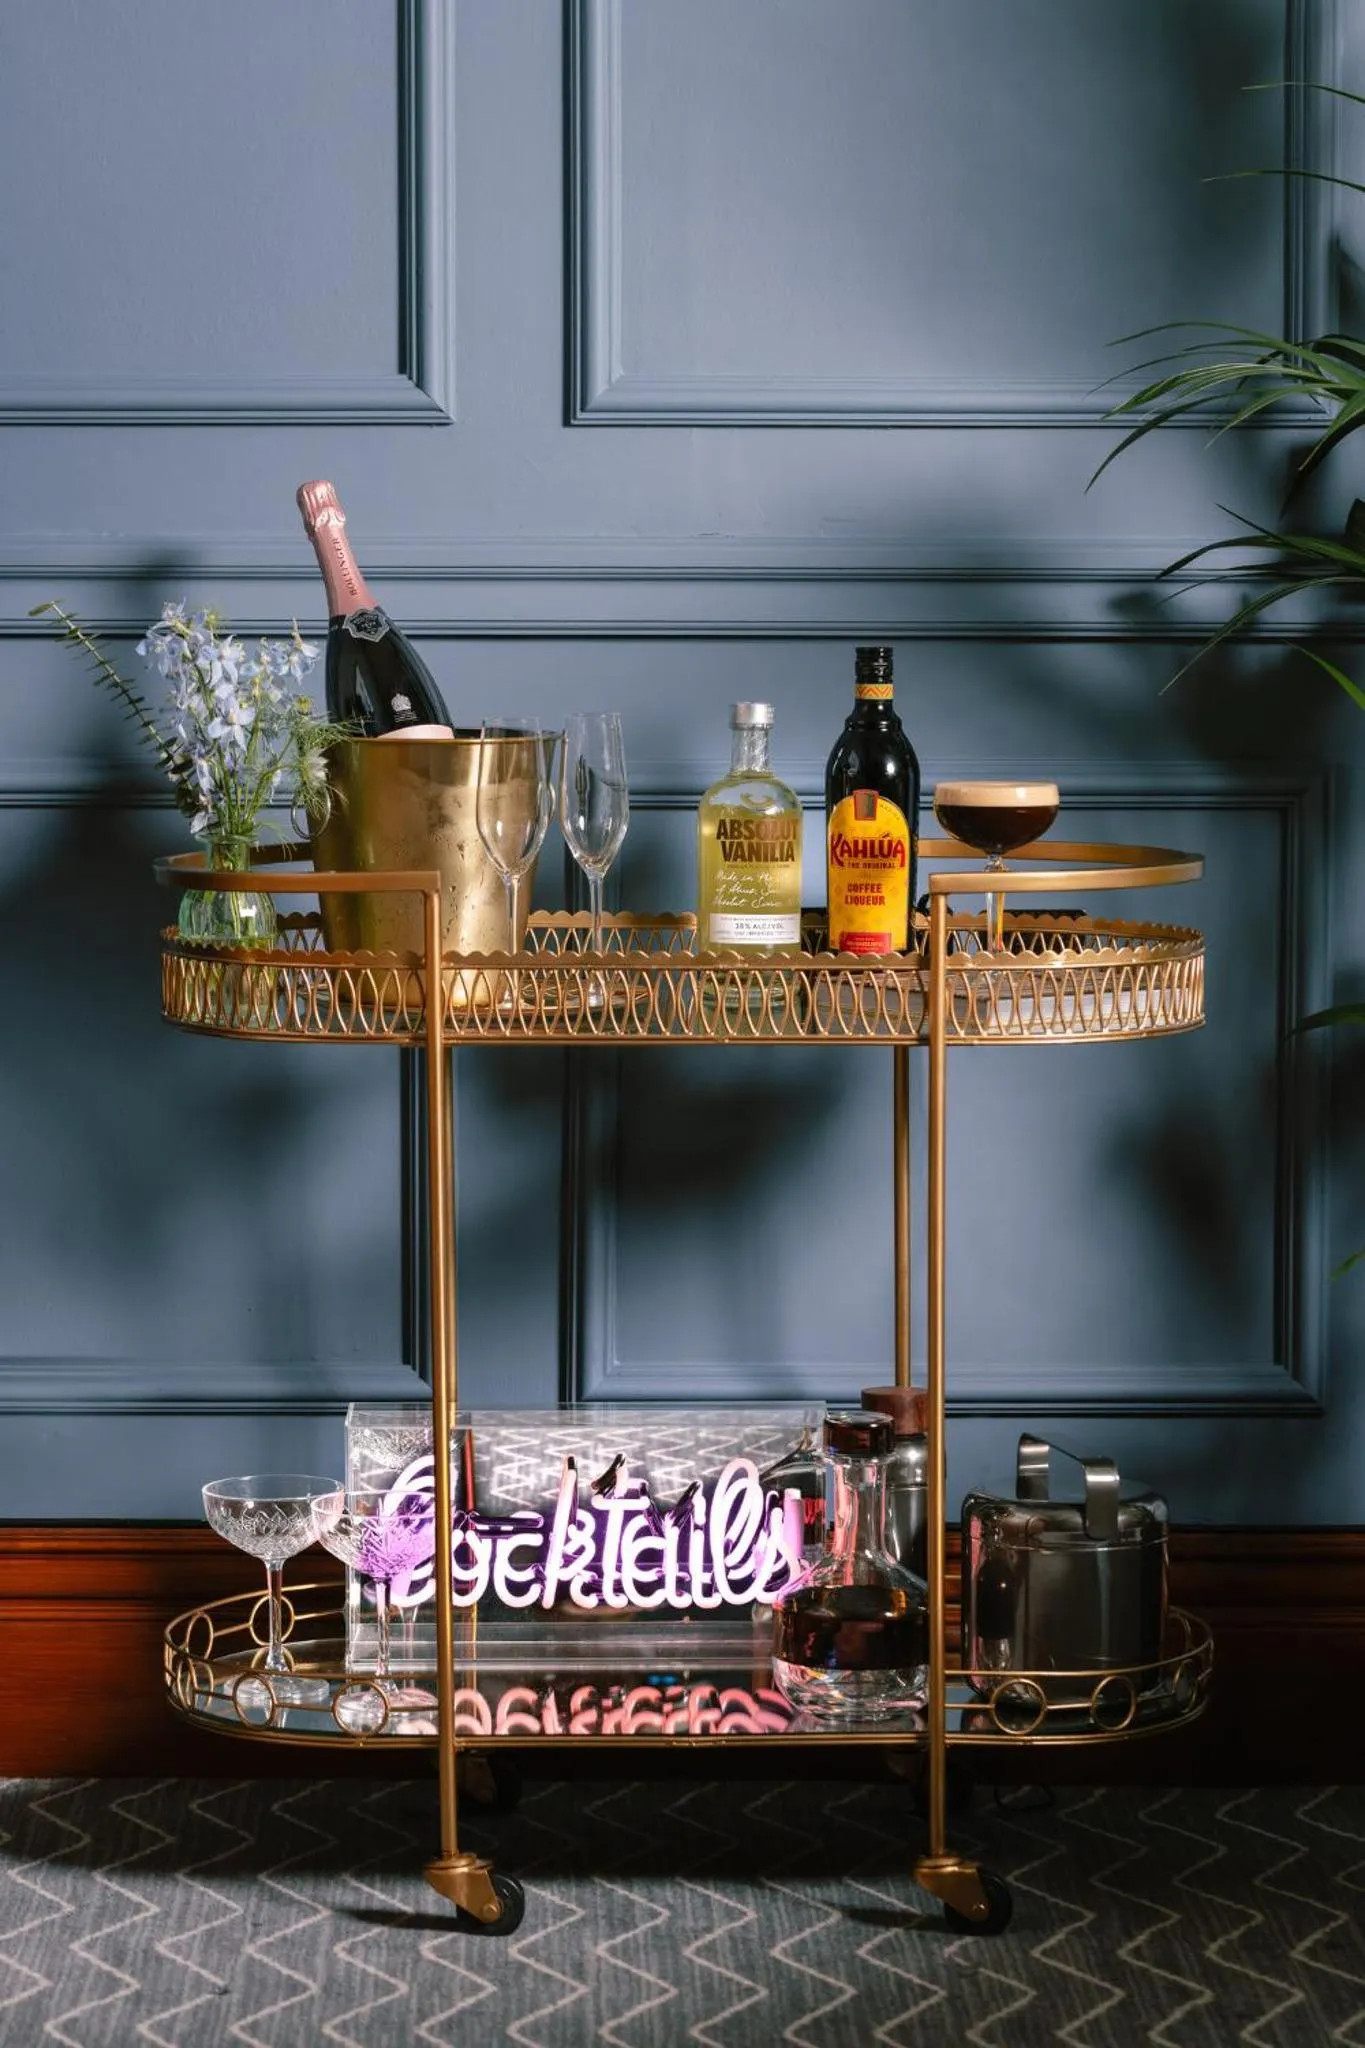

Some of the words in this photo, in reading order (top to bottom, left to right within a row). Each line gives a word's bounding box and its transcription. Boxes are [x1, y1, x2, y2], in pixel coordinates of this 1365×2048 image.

[716, 818, 799, 841] ABSOLUT
[720, 840, 796, 863] VANILIA
[830, 831, 906, 868] KAHLÚA
[862, 862, 897, 870] ORIGINAL
[847, 882, 883, 894] COFFEE
[844, 894, 886, 906] LIQUEUR
